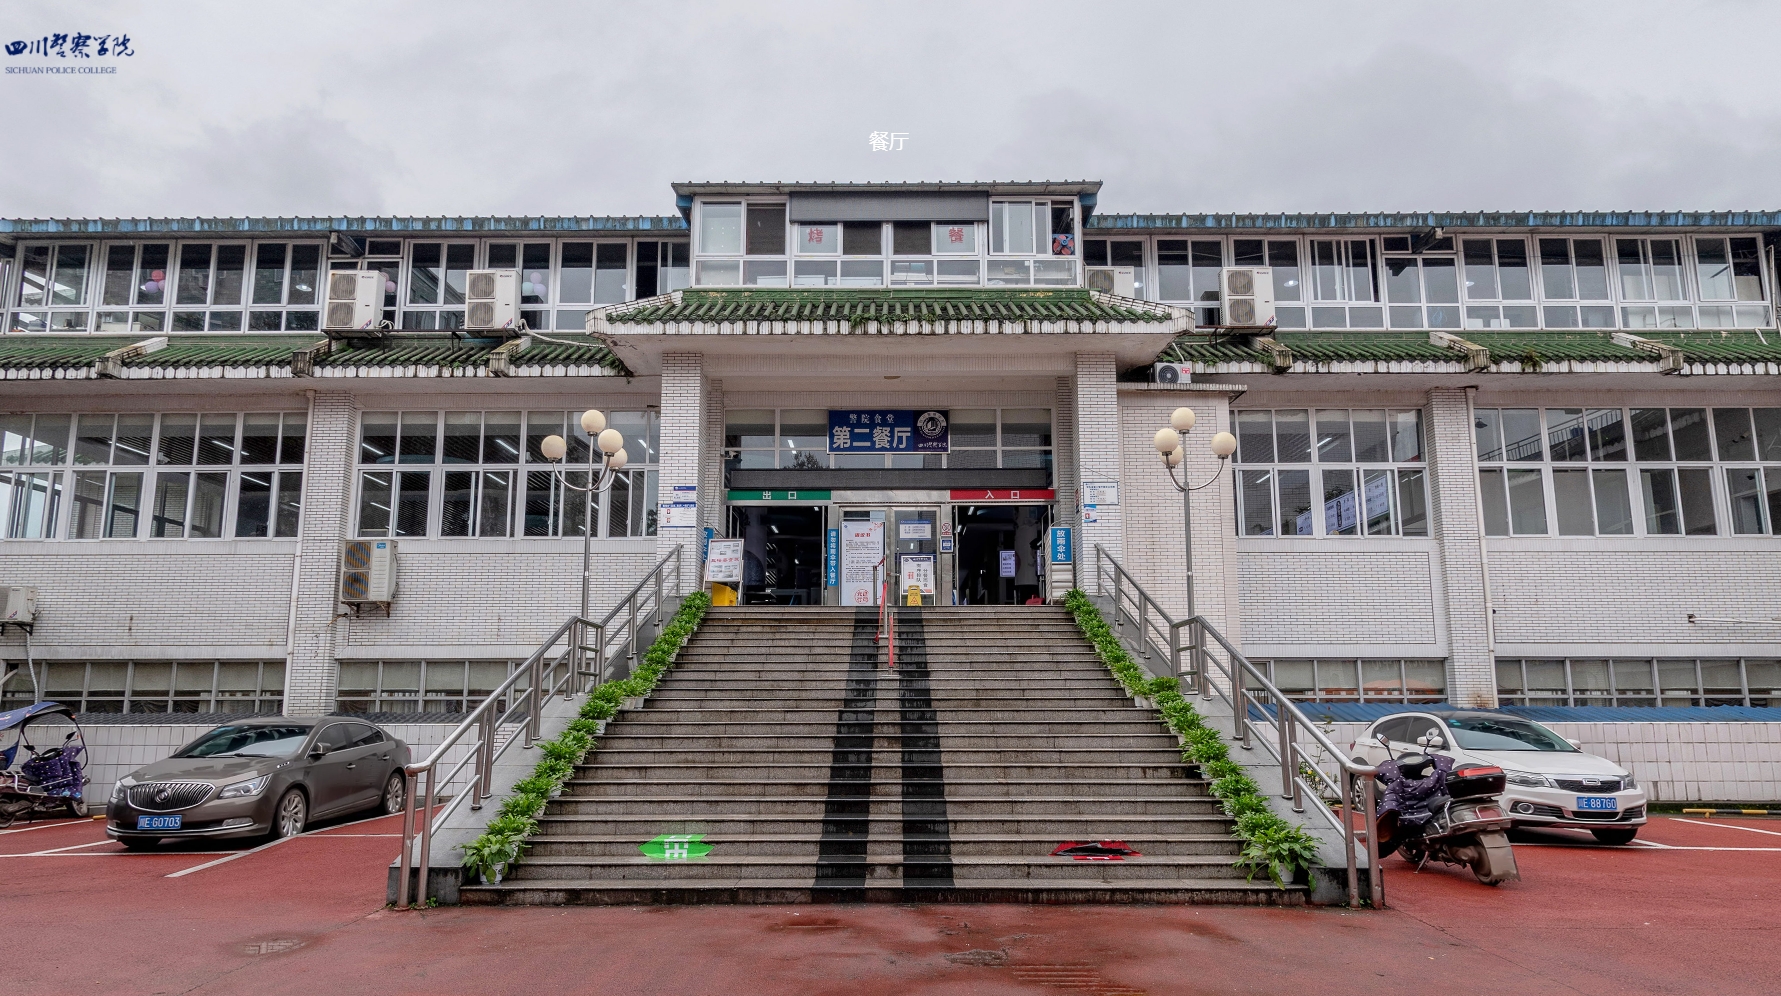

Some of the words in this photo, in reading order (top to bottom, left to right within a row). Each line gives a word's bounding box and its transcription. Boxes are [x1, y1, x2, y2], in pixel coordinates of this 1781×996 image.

[807, 227, 824, 244] 烤
[948, 226, 965, 244] 餐
[849, 413, 895, 424] 警院食堂
[832, 425, 912, 449] 第二餐厅
[762, 490, 797, 500] 出口
[984, 490, 1020, 499] 入口
[1056, 529, 1066, 561] 放雨伞处
